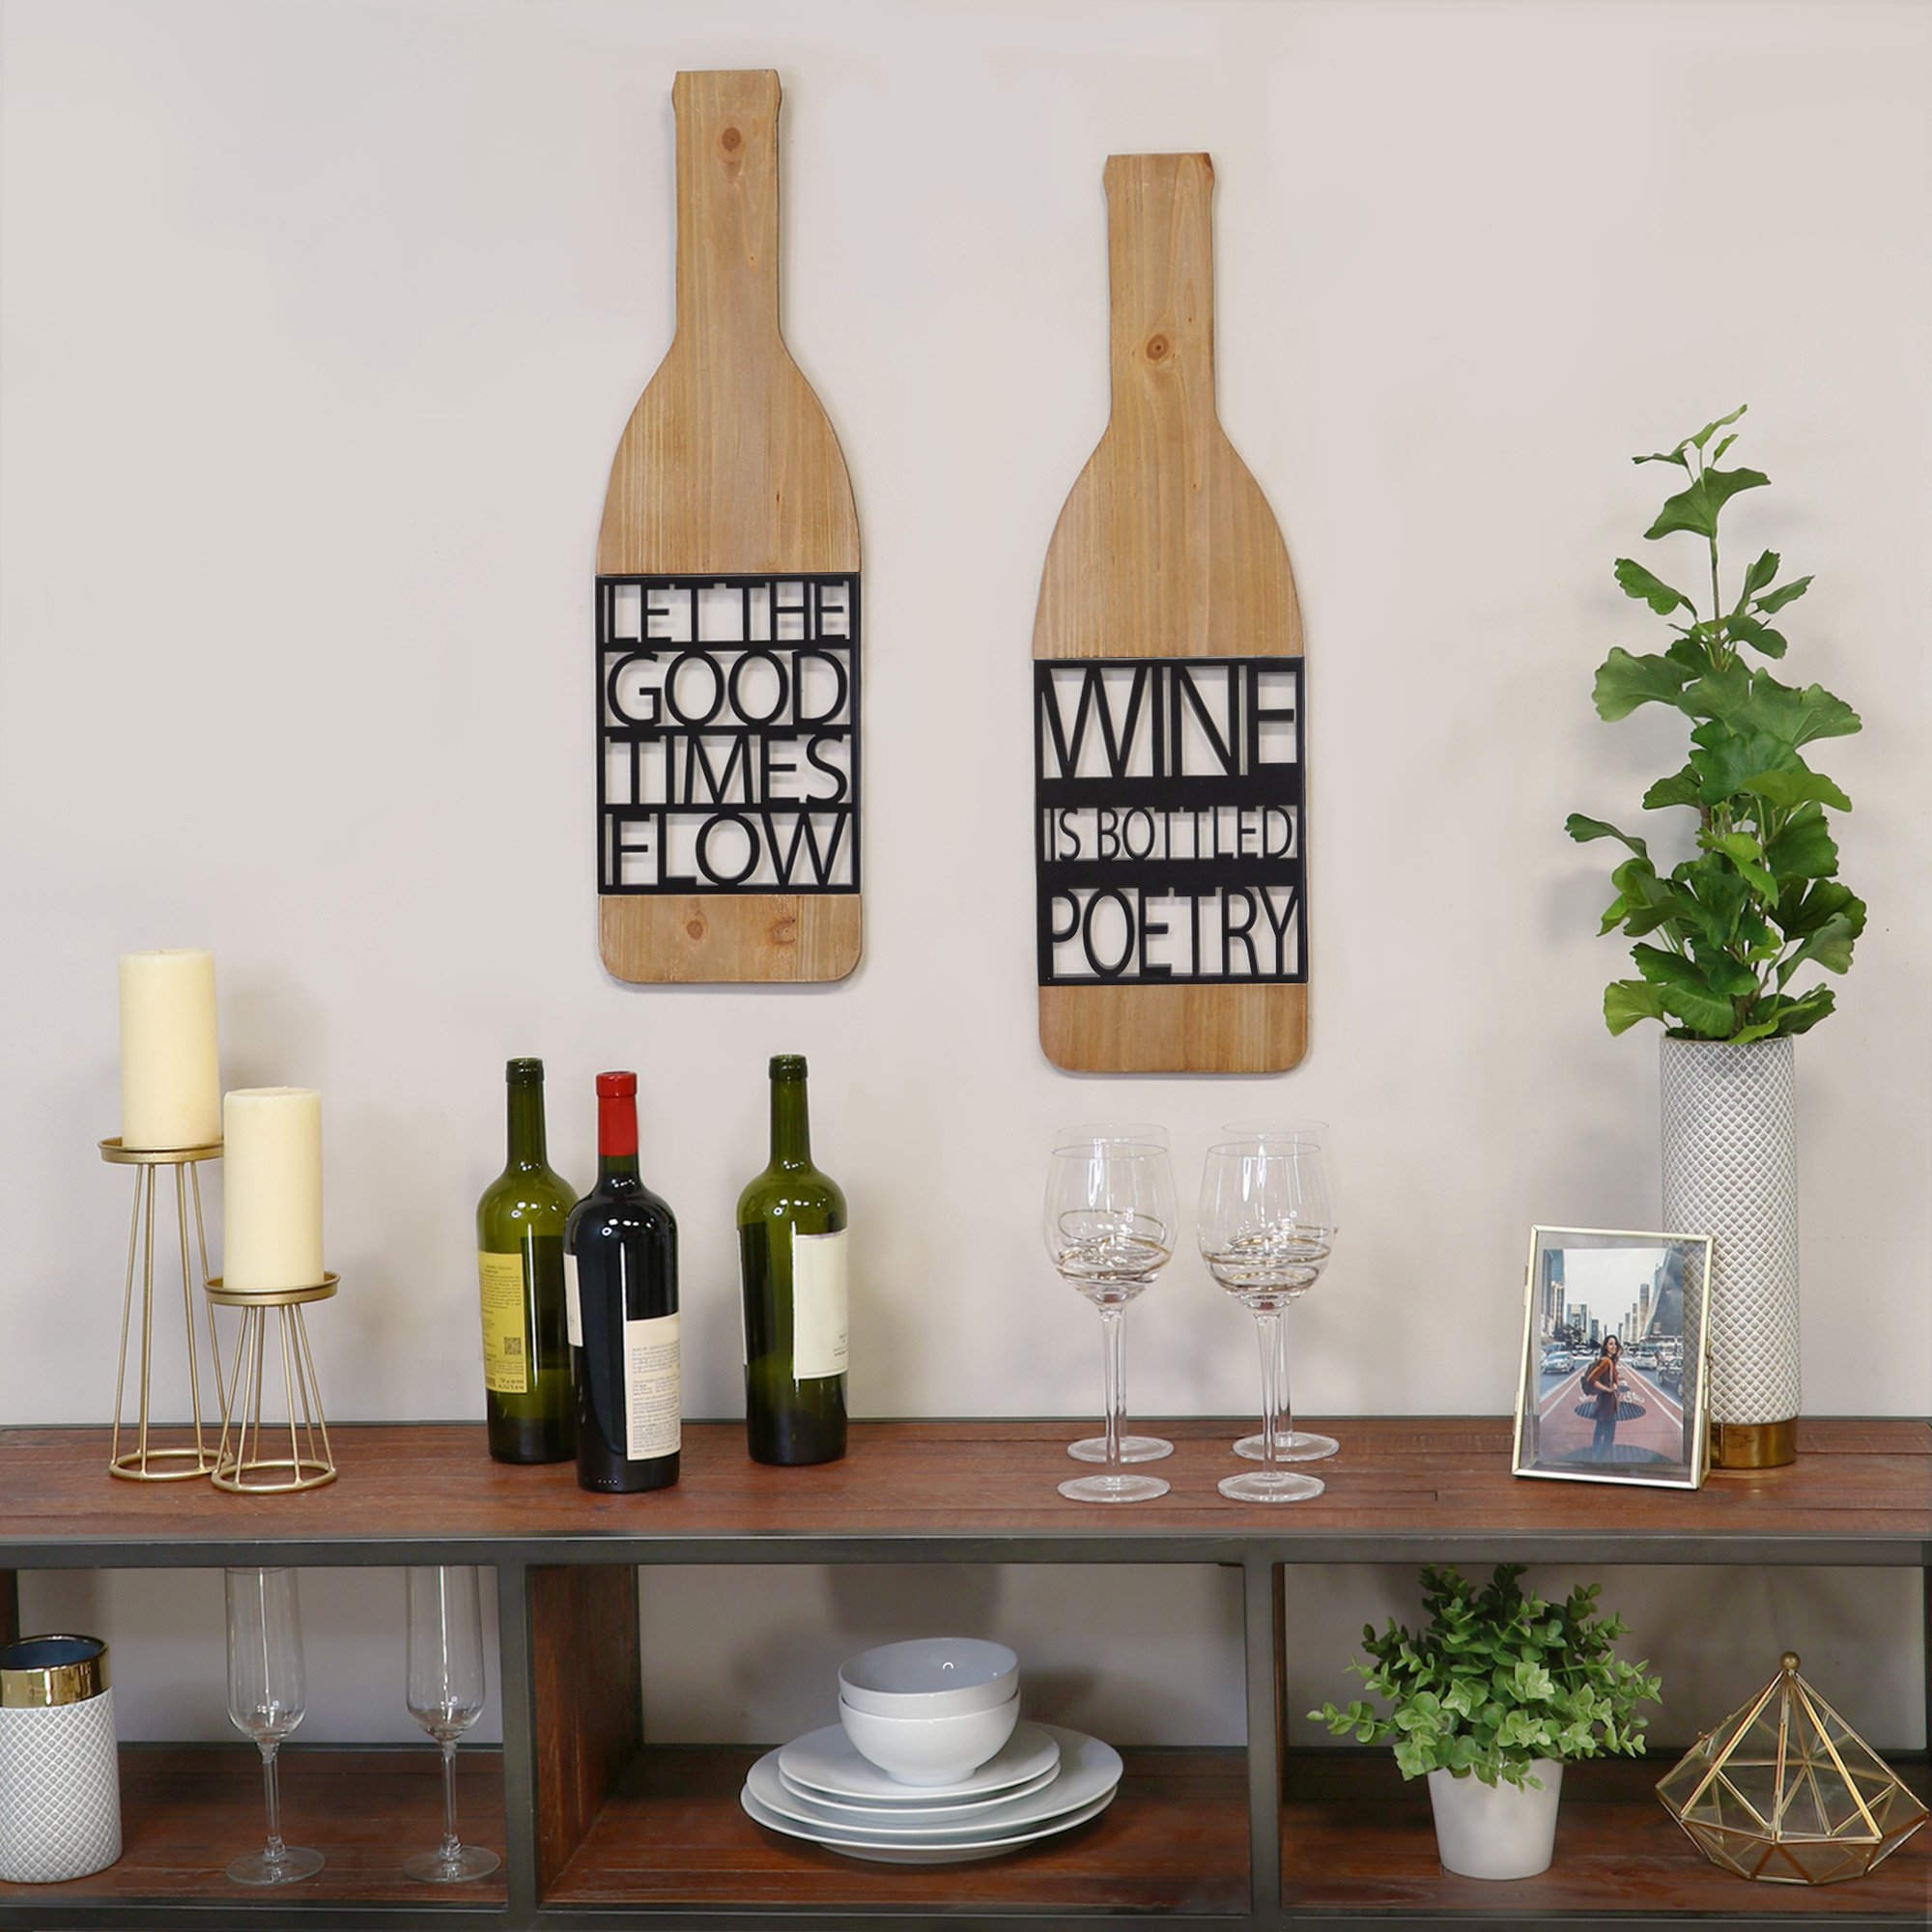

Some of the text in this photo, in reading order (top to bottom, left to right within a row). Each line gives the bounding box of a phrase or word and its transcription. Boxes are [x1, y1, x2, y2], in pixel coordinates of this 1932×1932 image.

[609, 581, 846, 641] LET THE
[608, 650, 847, 725] GOOD
[1037, 666, 1296, 776] WINE
[610, 734, 847, 804] TIMES
[611, 812, 849, 886] FLOW
[1050, 806, 1293, 861] IS BOTTLED
[1044, 887, 1299, 977] POETRY
